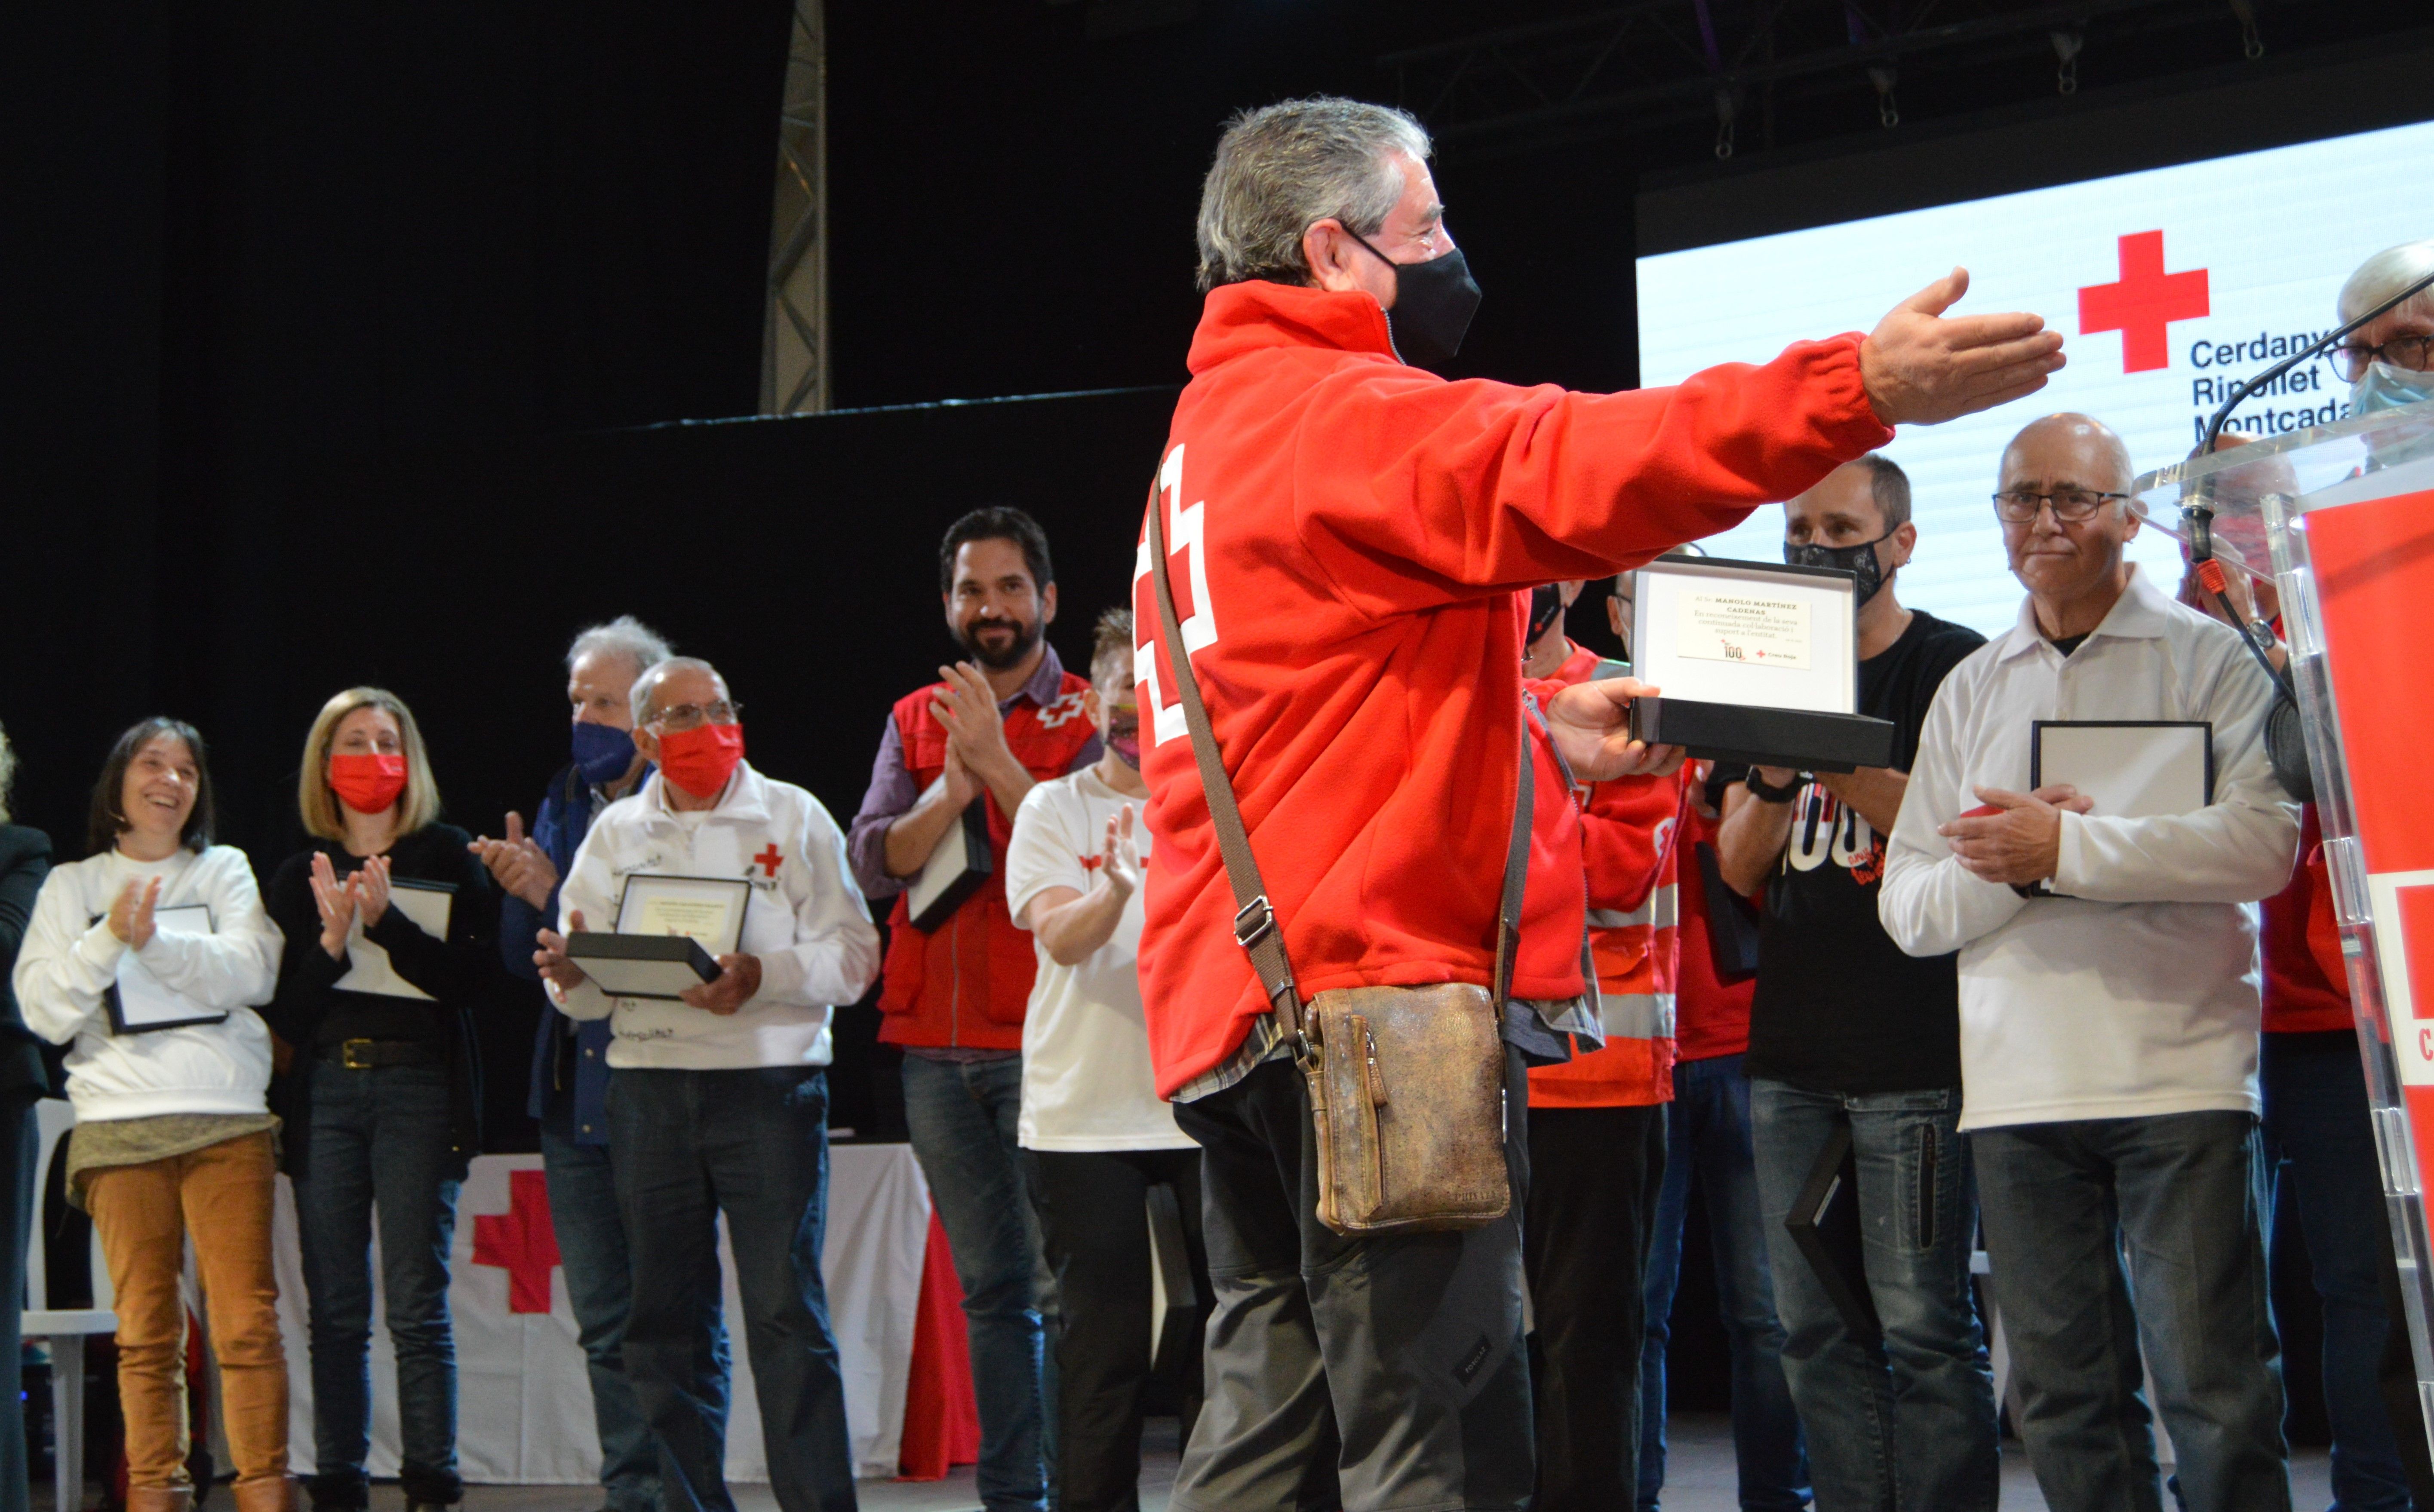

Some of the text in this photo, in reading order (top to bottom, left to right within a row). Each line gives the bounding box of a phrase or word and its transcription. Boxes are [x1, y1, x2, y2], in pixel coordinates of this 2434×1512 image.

[1754, 601, 1797, 610] MARTÍNEZ
[1727, 607, 1766, 615] CADENAS
[1706, 612, 1761, 622] reconeixement
[1724, 645, 1742, 659] 100
